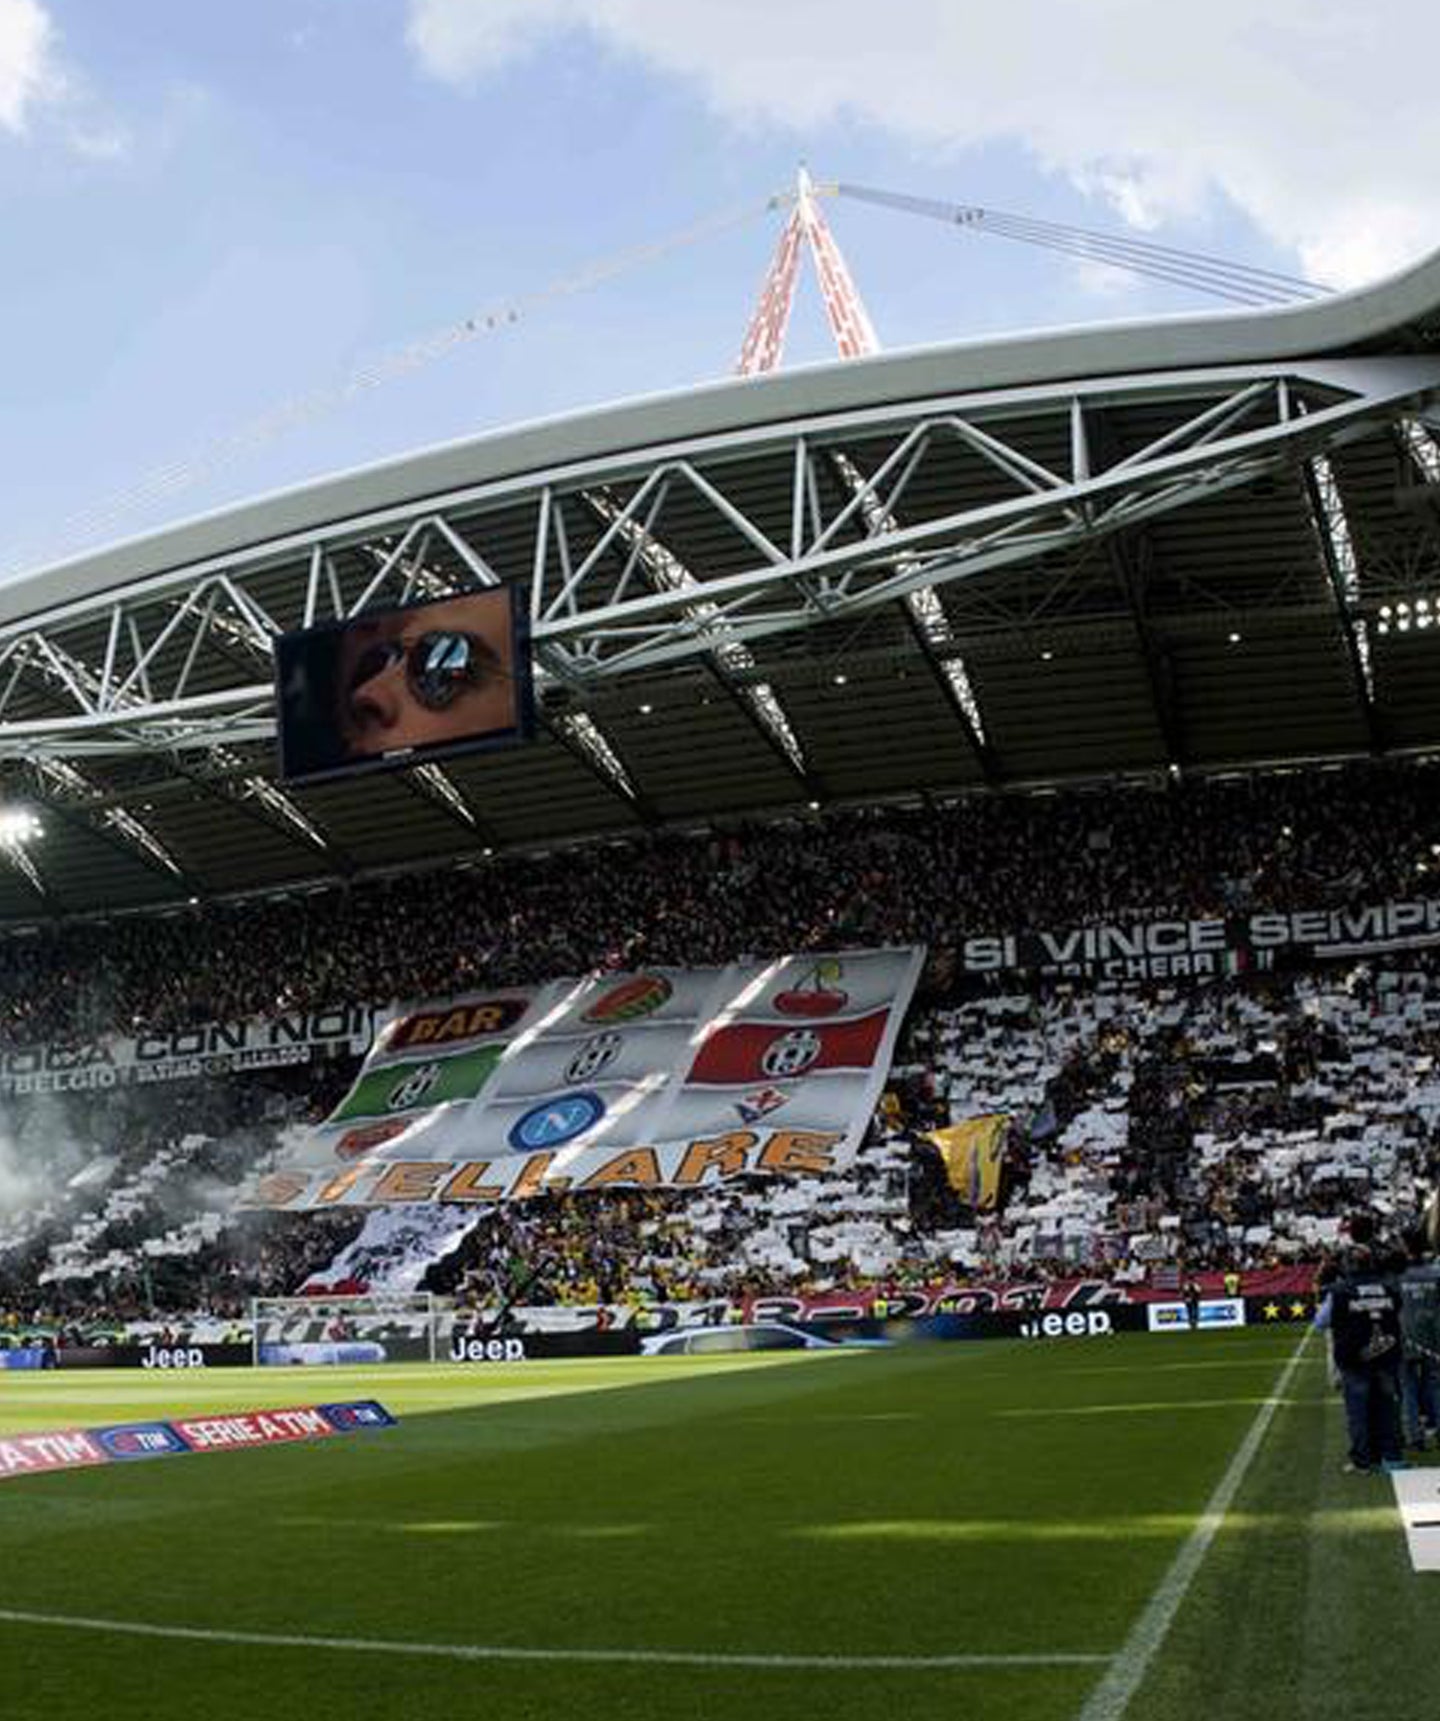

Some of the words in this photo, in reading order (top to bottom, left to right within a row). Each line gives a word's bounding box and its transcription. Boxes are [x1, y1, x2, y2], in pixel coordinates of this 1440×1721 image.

[964, 936, 1017, 970] SI
[1039, 919, 1226, 961] VINCE
[136, 1022, 247, 1060] CON
[271, 1006, 367, 1042] NOI
[409, 1006, 504, 1043] BAR
[142, 1345, 205, 1369] Jeep
[450, 1336, 525, 1362] Jeep
[25, 1431, 99, 1463] TIM
